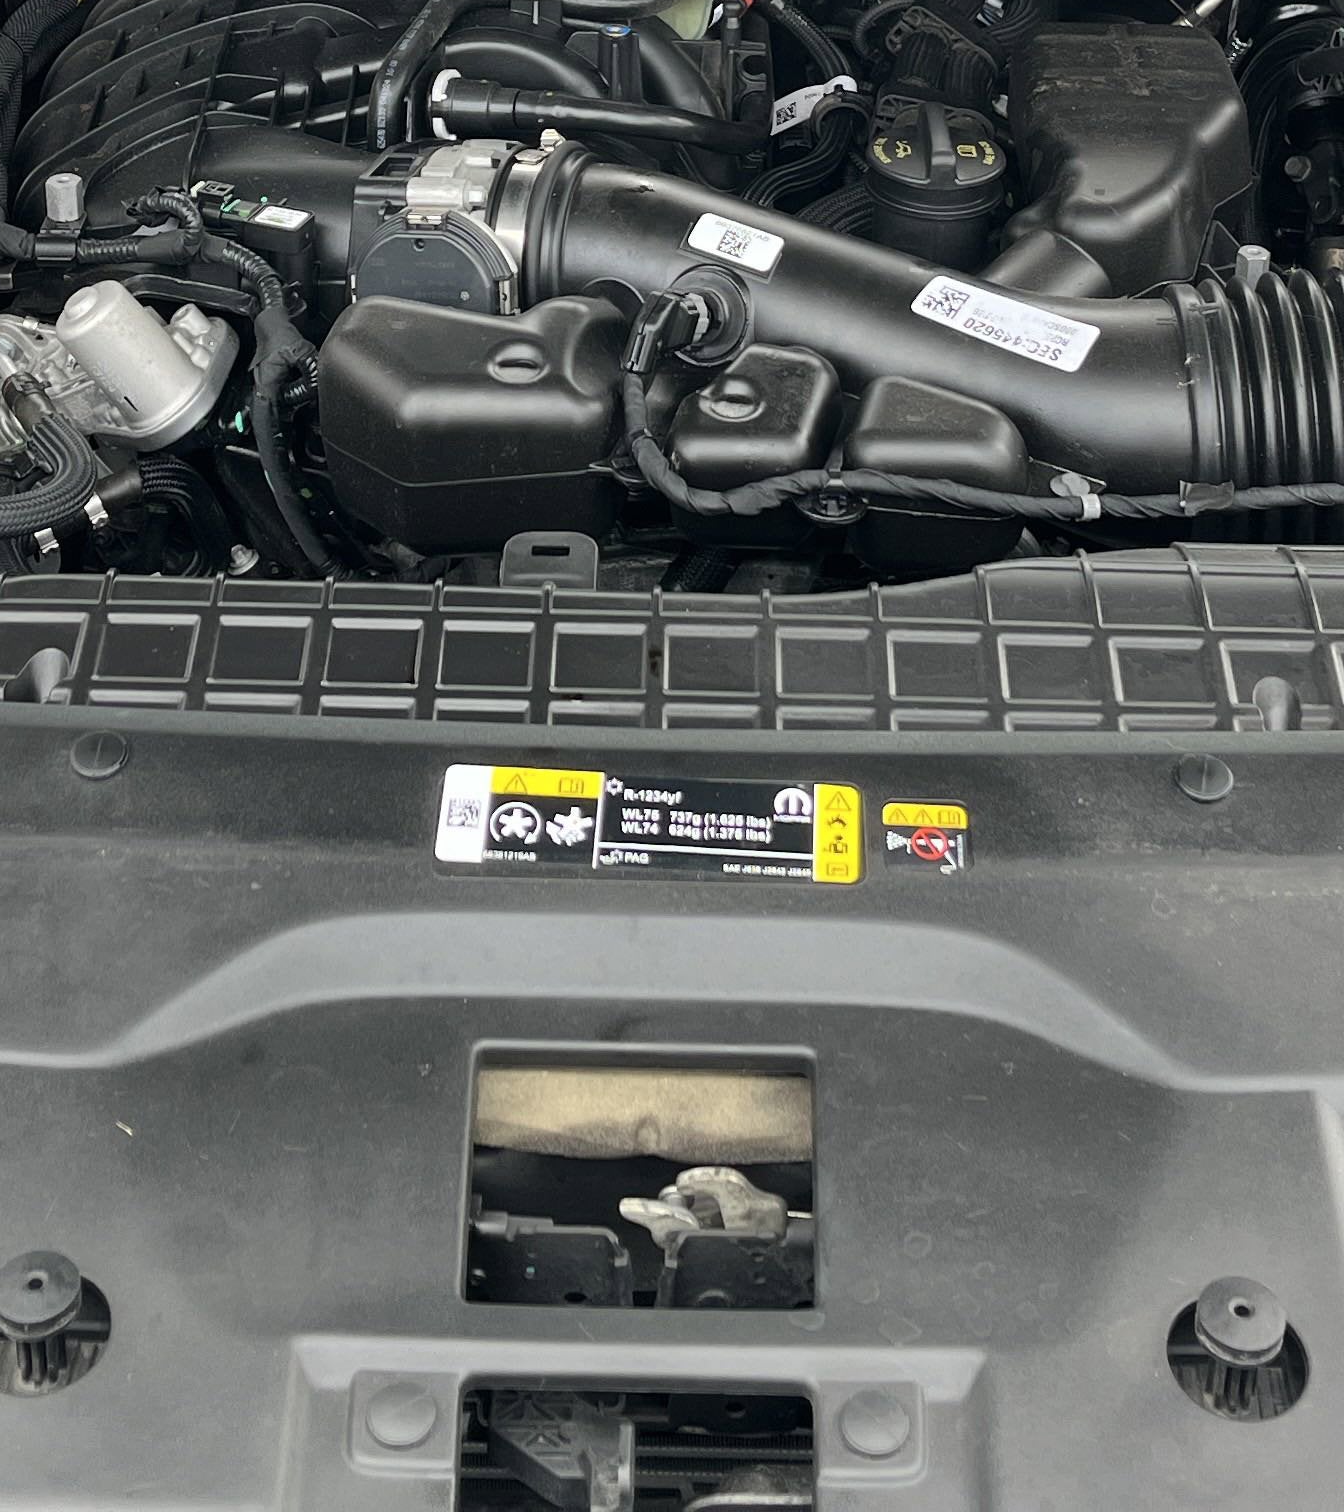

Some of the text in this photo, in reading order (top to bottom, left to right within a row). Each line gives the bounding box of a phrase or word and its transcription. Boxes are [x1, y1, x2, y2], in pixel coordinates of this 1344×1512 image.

[623, 788, 683, 806] R-1234yf
[621, 807, 773, 831] WL75 737g (1.625 lbs)
[620, 821, 773, 845] WL74 624g (1.375 lbs)
[624, 852, 650, 865] PAG
